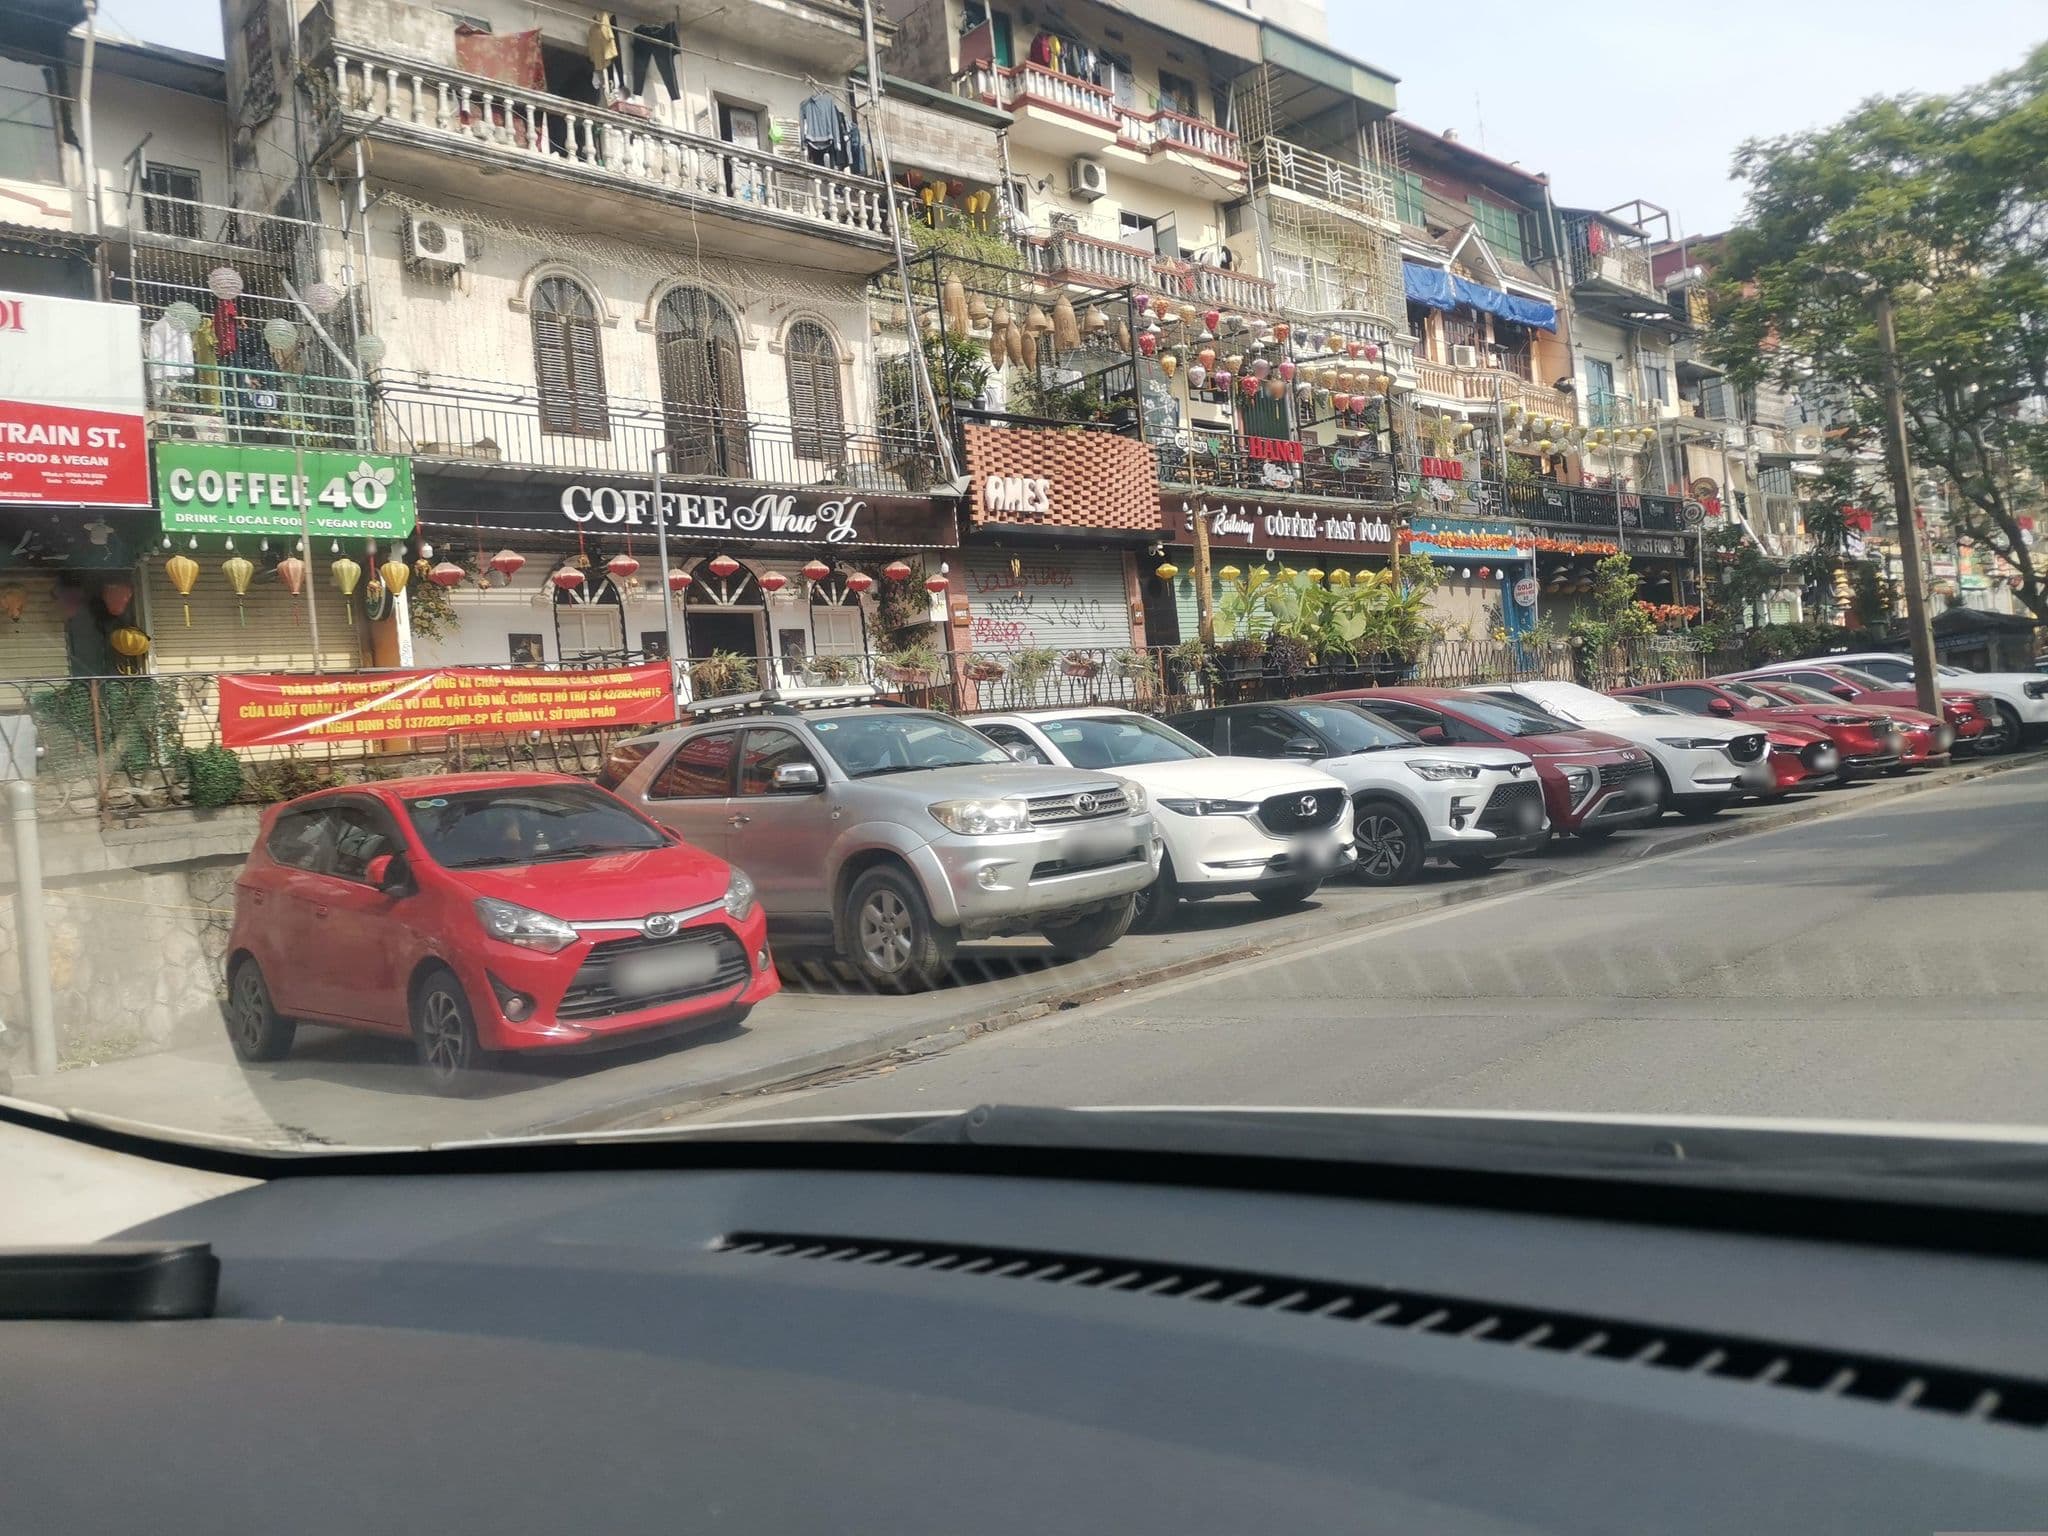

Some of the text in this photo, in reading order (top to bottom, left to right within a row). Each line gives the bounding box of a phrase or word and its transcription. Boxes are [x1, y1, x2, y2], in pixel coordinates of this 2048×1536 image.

[258, 395, 273, 406] 40
[86, 427, 126, 449] ST.
[6, 452, 48, 463] FOOD
[50, 454, 61, 465] &
[62, 455, 109, 466] VEGAN
[169, 468, 387, 510] COFFEE 40
[560, 486, 731, 530] COFFEE
[175, 512, 218, 524] DRINK
[228, 515, 271, 526] LOCAL
[317, 518, 358, 529] VEGAN
[361, 520, 393, 531] FOOD
[1212, 513, 1254, 544] Railway
[1265, 515, 1317, 538] COFFEE
[1325, 519, 1356, 540] FAST
[1360, 521, 1391, 543] FOOD
[239, 701, 265, 718] CỦA
